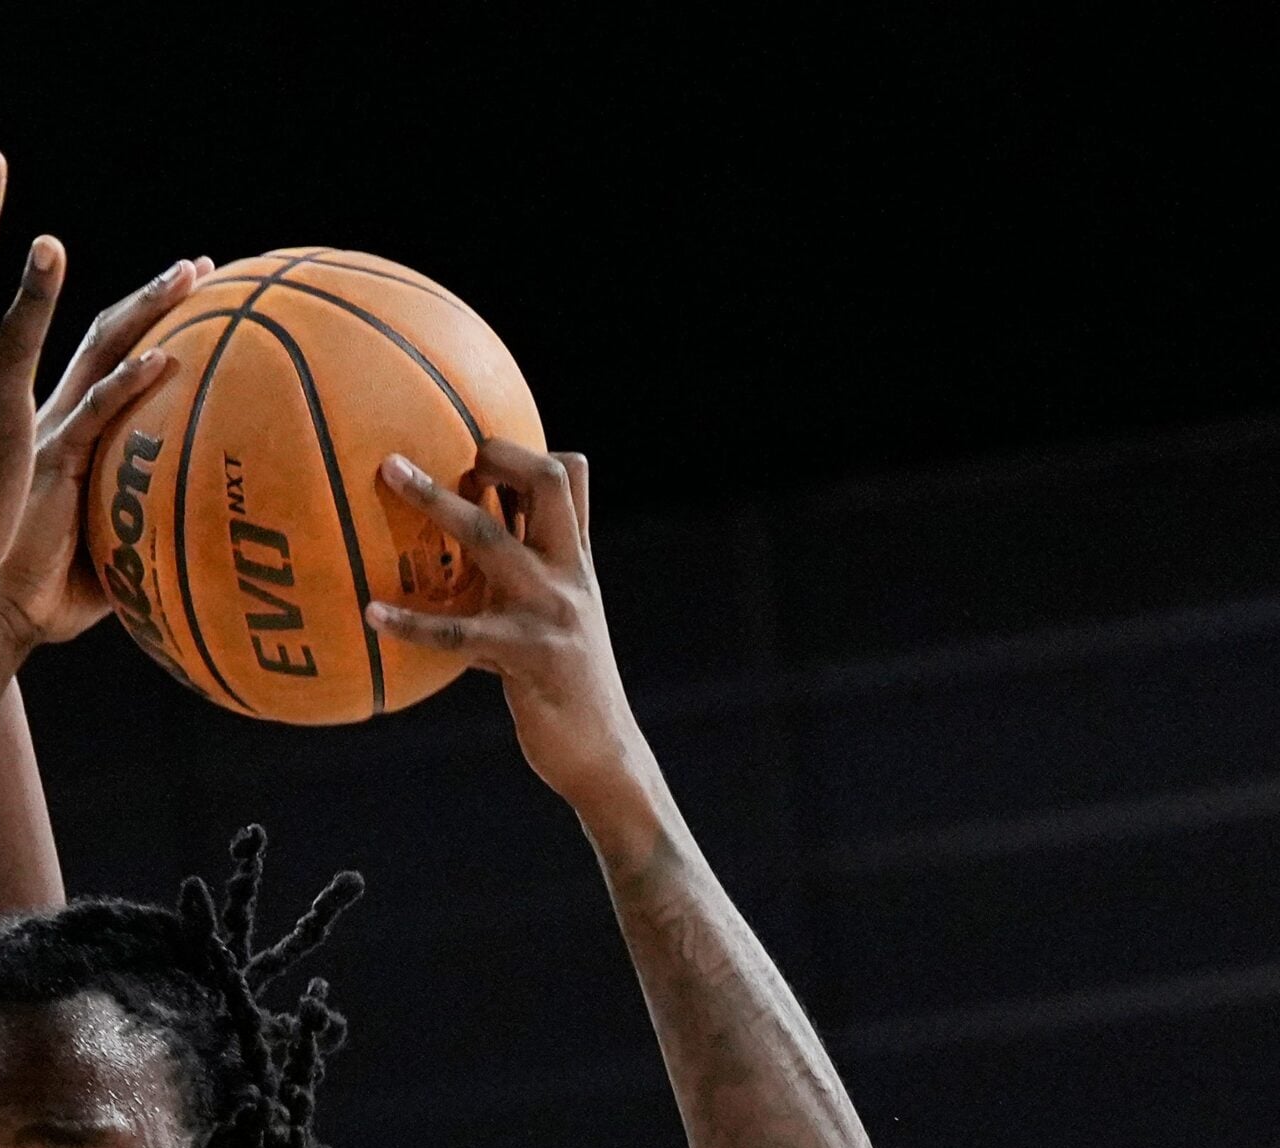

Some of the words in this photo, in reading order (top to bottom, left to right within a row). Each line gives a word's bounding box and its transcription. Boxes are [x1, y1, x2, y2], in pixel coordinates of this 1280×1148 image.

[104, 429, 190, 682] ilson
[224, 450, 246, 515] NXT
[229, 518, 319, 677] EVO
